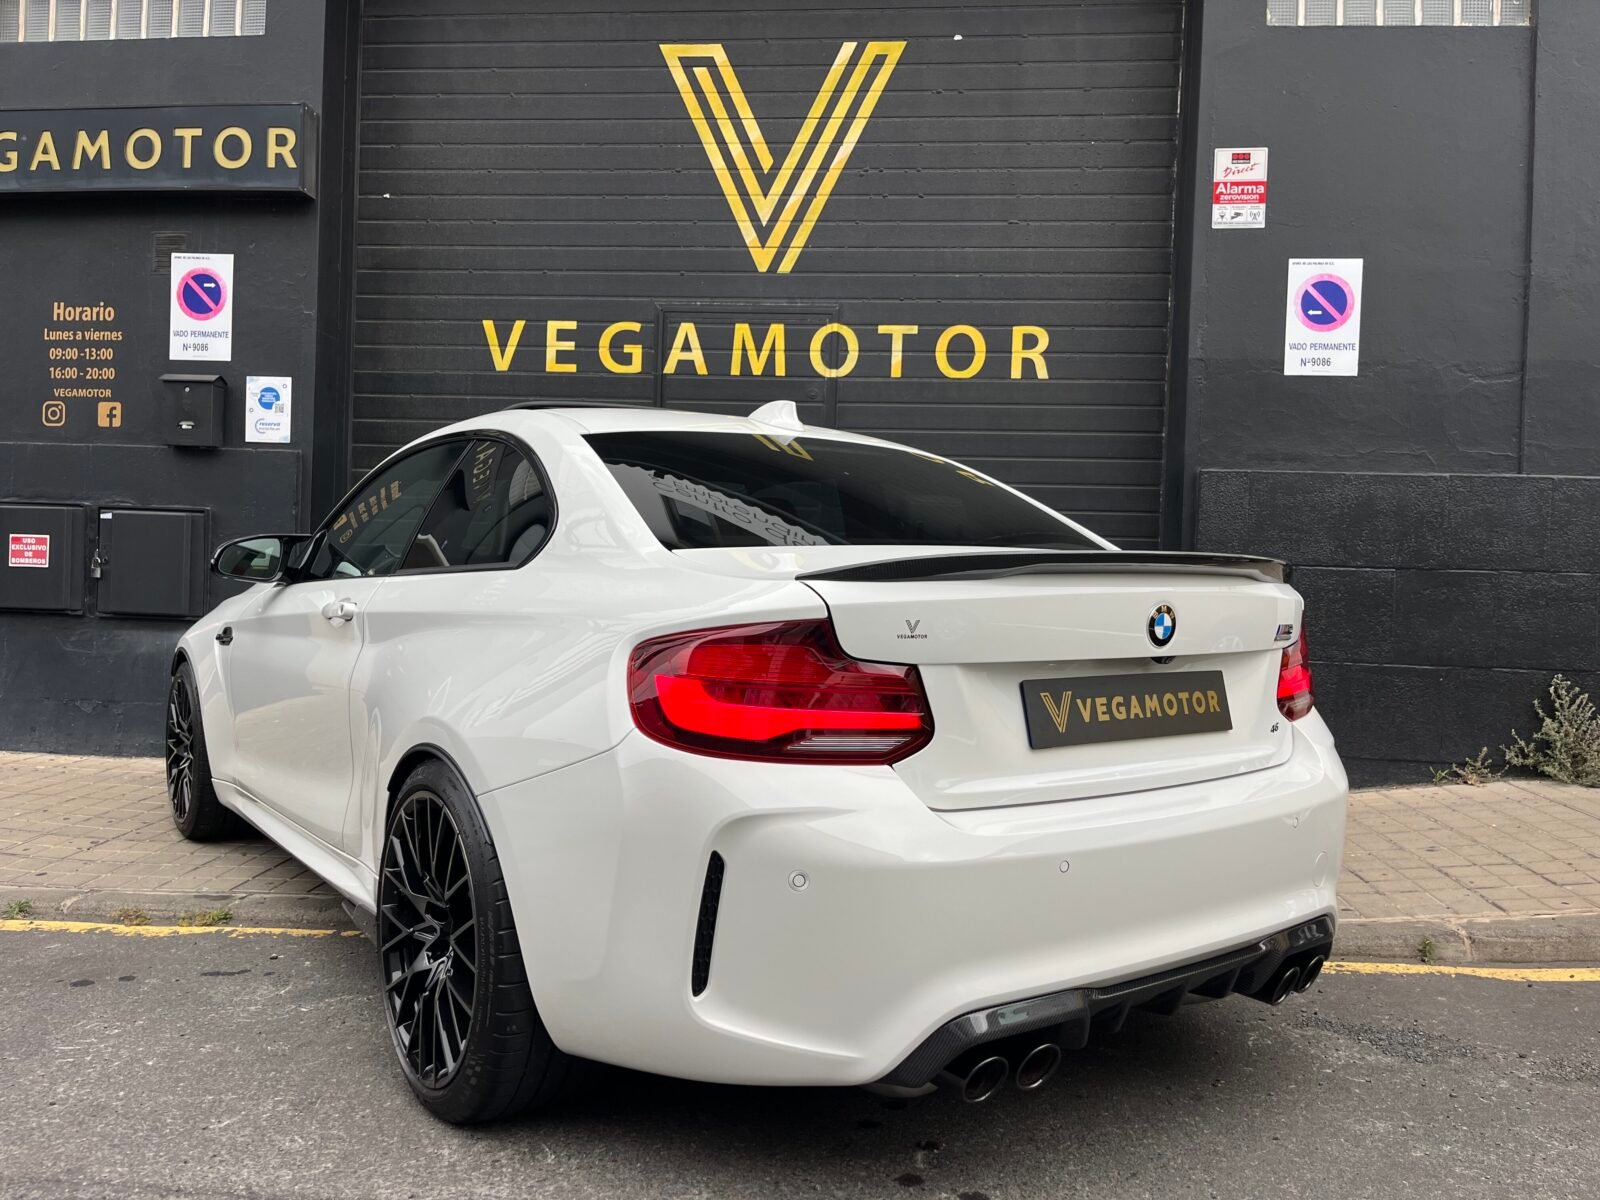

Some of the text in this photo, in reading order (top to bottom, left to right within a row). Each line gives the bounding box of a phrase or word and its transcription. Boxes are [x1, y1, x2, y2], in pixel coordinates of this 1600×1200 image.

[1215, 182, 1265, 195] Alarma
[53, 301, 115, 321] Horario
[43, 328, 123, 341] Lunes a viernes
[172, 329, 230, 339] VADO PERMANENTE
[482, 319, 1050, 379] VEGAMOTOR
[1288, 342, 1357, 351] VADO PERMANENTE
[49, 347, 78, 360] 09:00
[49, 367, 78, 379] 16:00
[85, 367, 116, 380] 20:00
[53, 388, 112, 398] VEGAMOTOR
[1151, 605, 1176, 619] BMW
[1076, 690, 1220, 723] VEGAMOTOR
